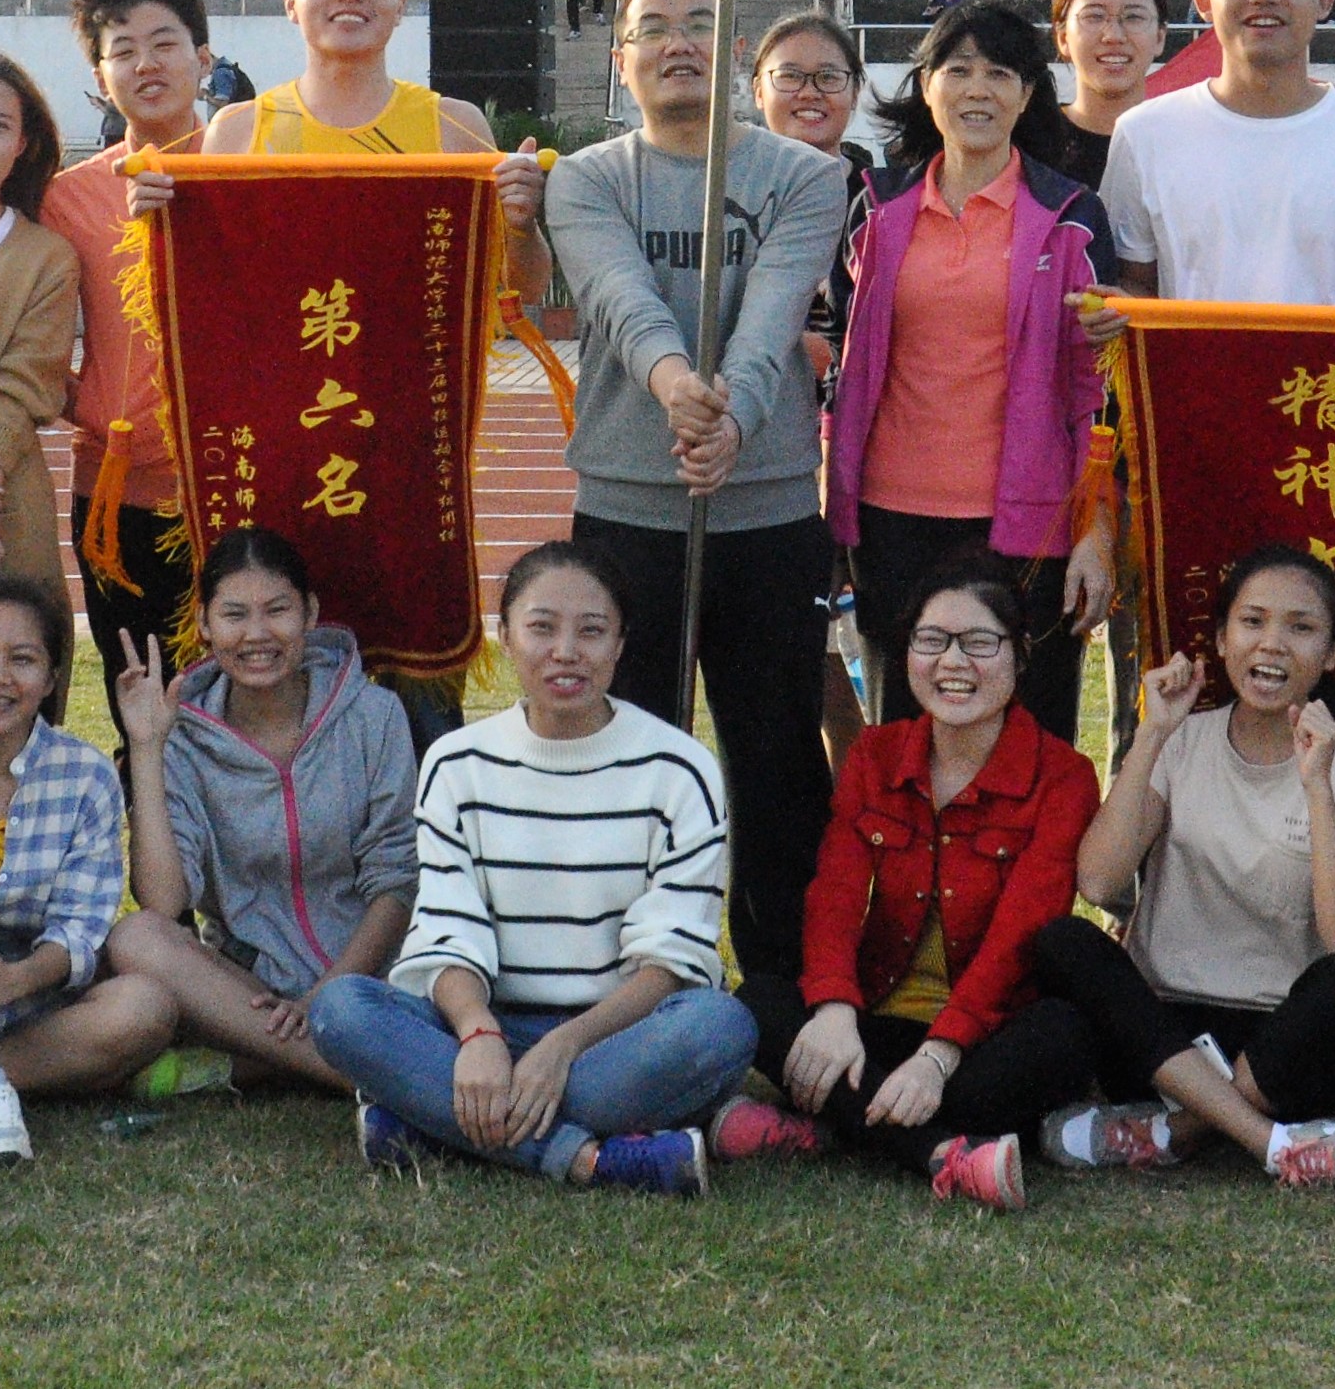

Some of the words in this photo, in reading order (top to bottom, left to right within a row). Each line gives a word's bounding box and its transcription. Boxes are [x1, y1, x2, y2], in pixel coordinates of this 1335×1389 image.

[202, 425, 228, 546] 二〇一六年
[298, 278, 375, 517] 第六名
